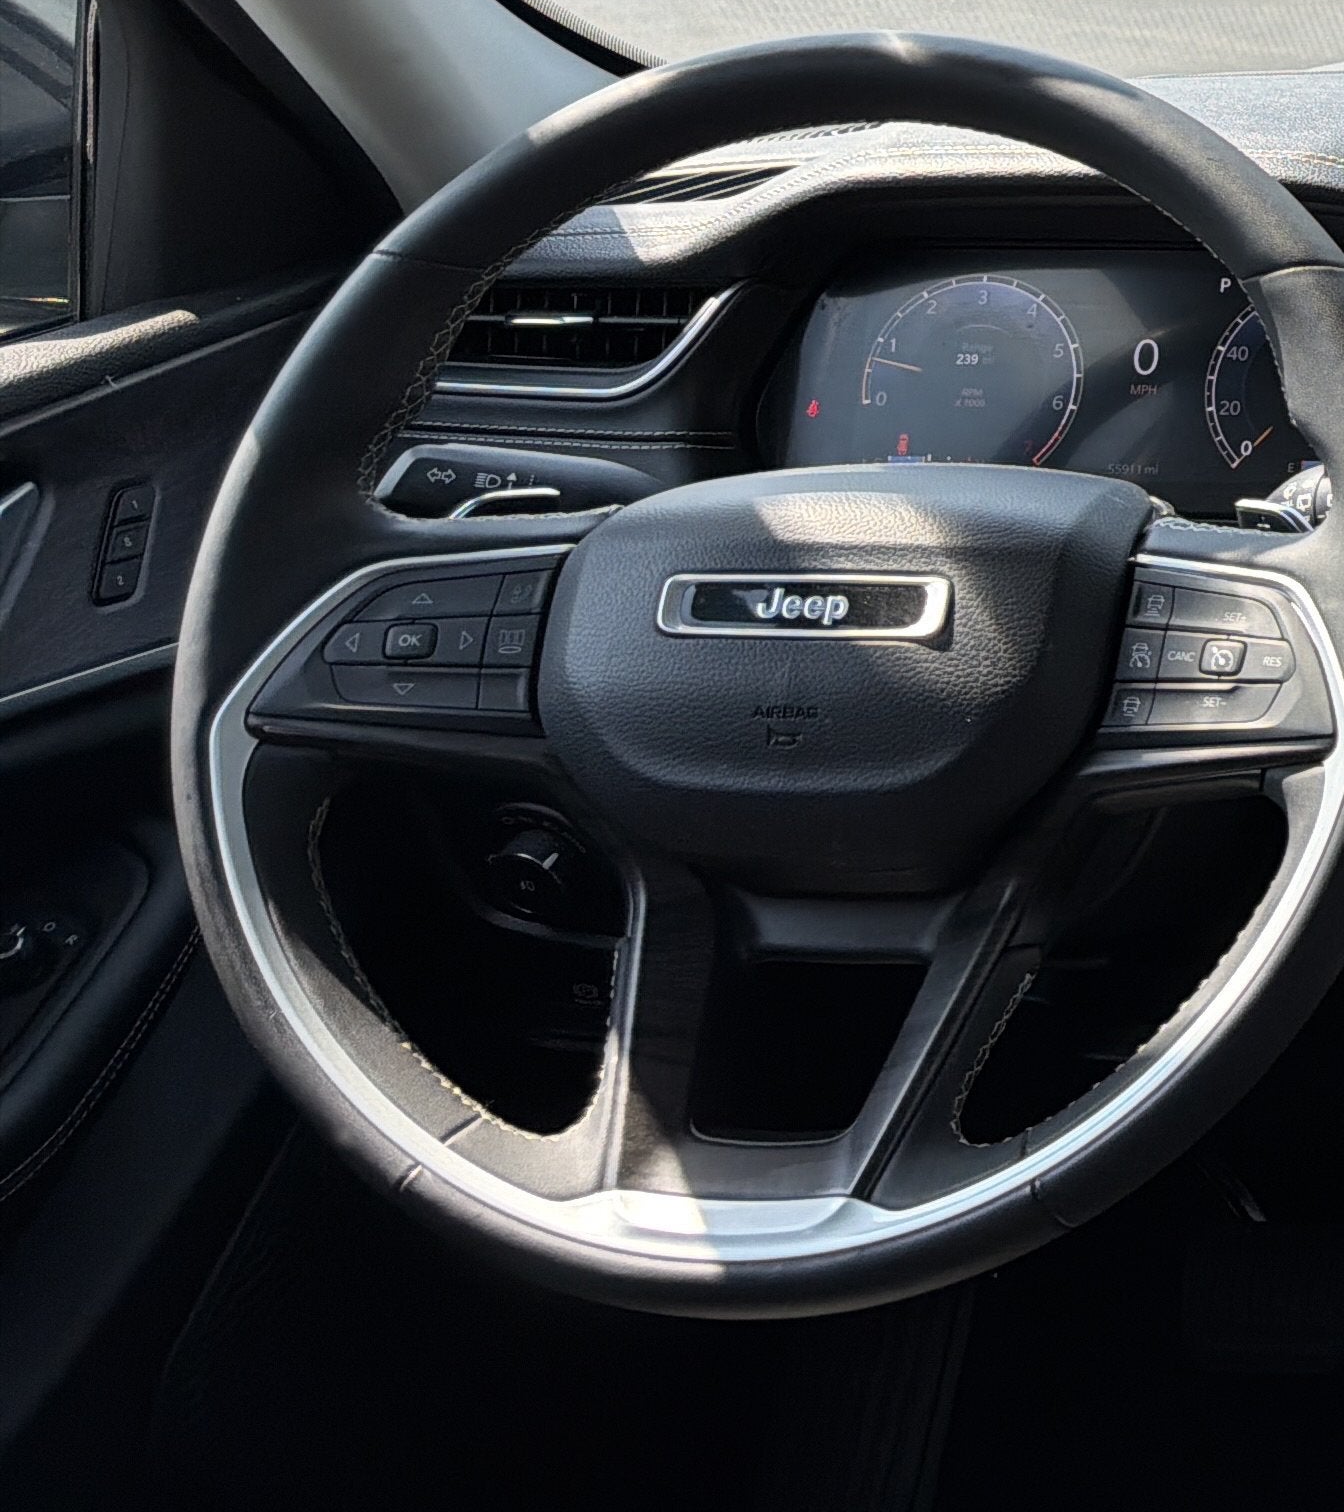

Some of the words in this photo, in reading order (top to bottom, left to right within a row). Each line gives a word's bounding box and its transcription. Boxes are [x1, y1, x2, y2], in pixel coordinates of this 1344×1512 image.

[1220, 278, 1231, 293] P
[977, 290, 988, 305] 3
[926, 301, 937, 315] 2
[1027, 304, 1037, 317] 4
[889, 338, 896, 352] 1
[1053, 344, 1064, 358] 5
[955, 354, 979, 365] 239
[1134, 339, 1159, 376] 0
[1227, 346, 1248, 361] 40
[1130, 384, 1157, 395] MPH
[876, 392, 887, 406] 0
[1052, 396, 1063, 410] 6
[1220, 401, 1241, 416] 20
[1241, 440, 1252, 456] 0
[1287, 463, 1294, 473] E
[117, 575, 124, 585] 2
[756, 589, 849, 625] Jeep
[397, 633, 423, 647] OK
[1167, 650, 1196, 663] CANC
[1263, 656, 1282, 667] RES
[751, 705, 819, 720] AIRBAG
